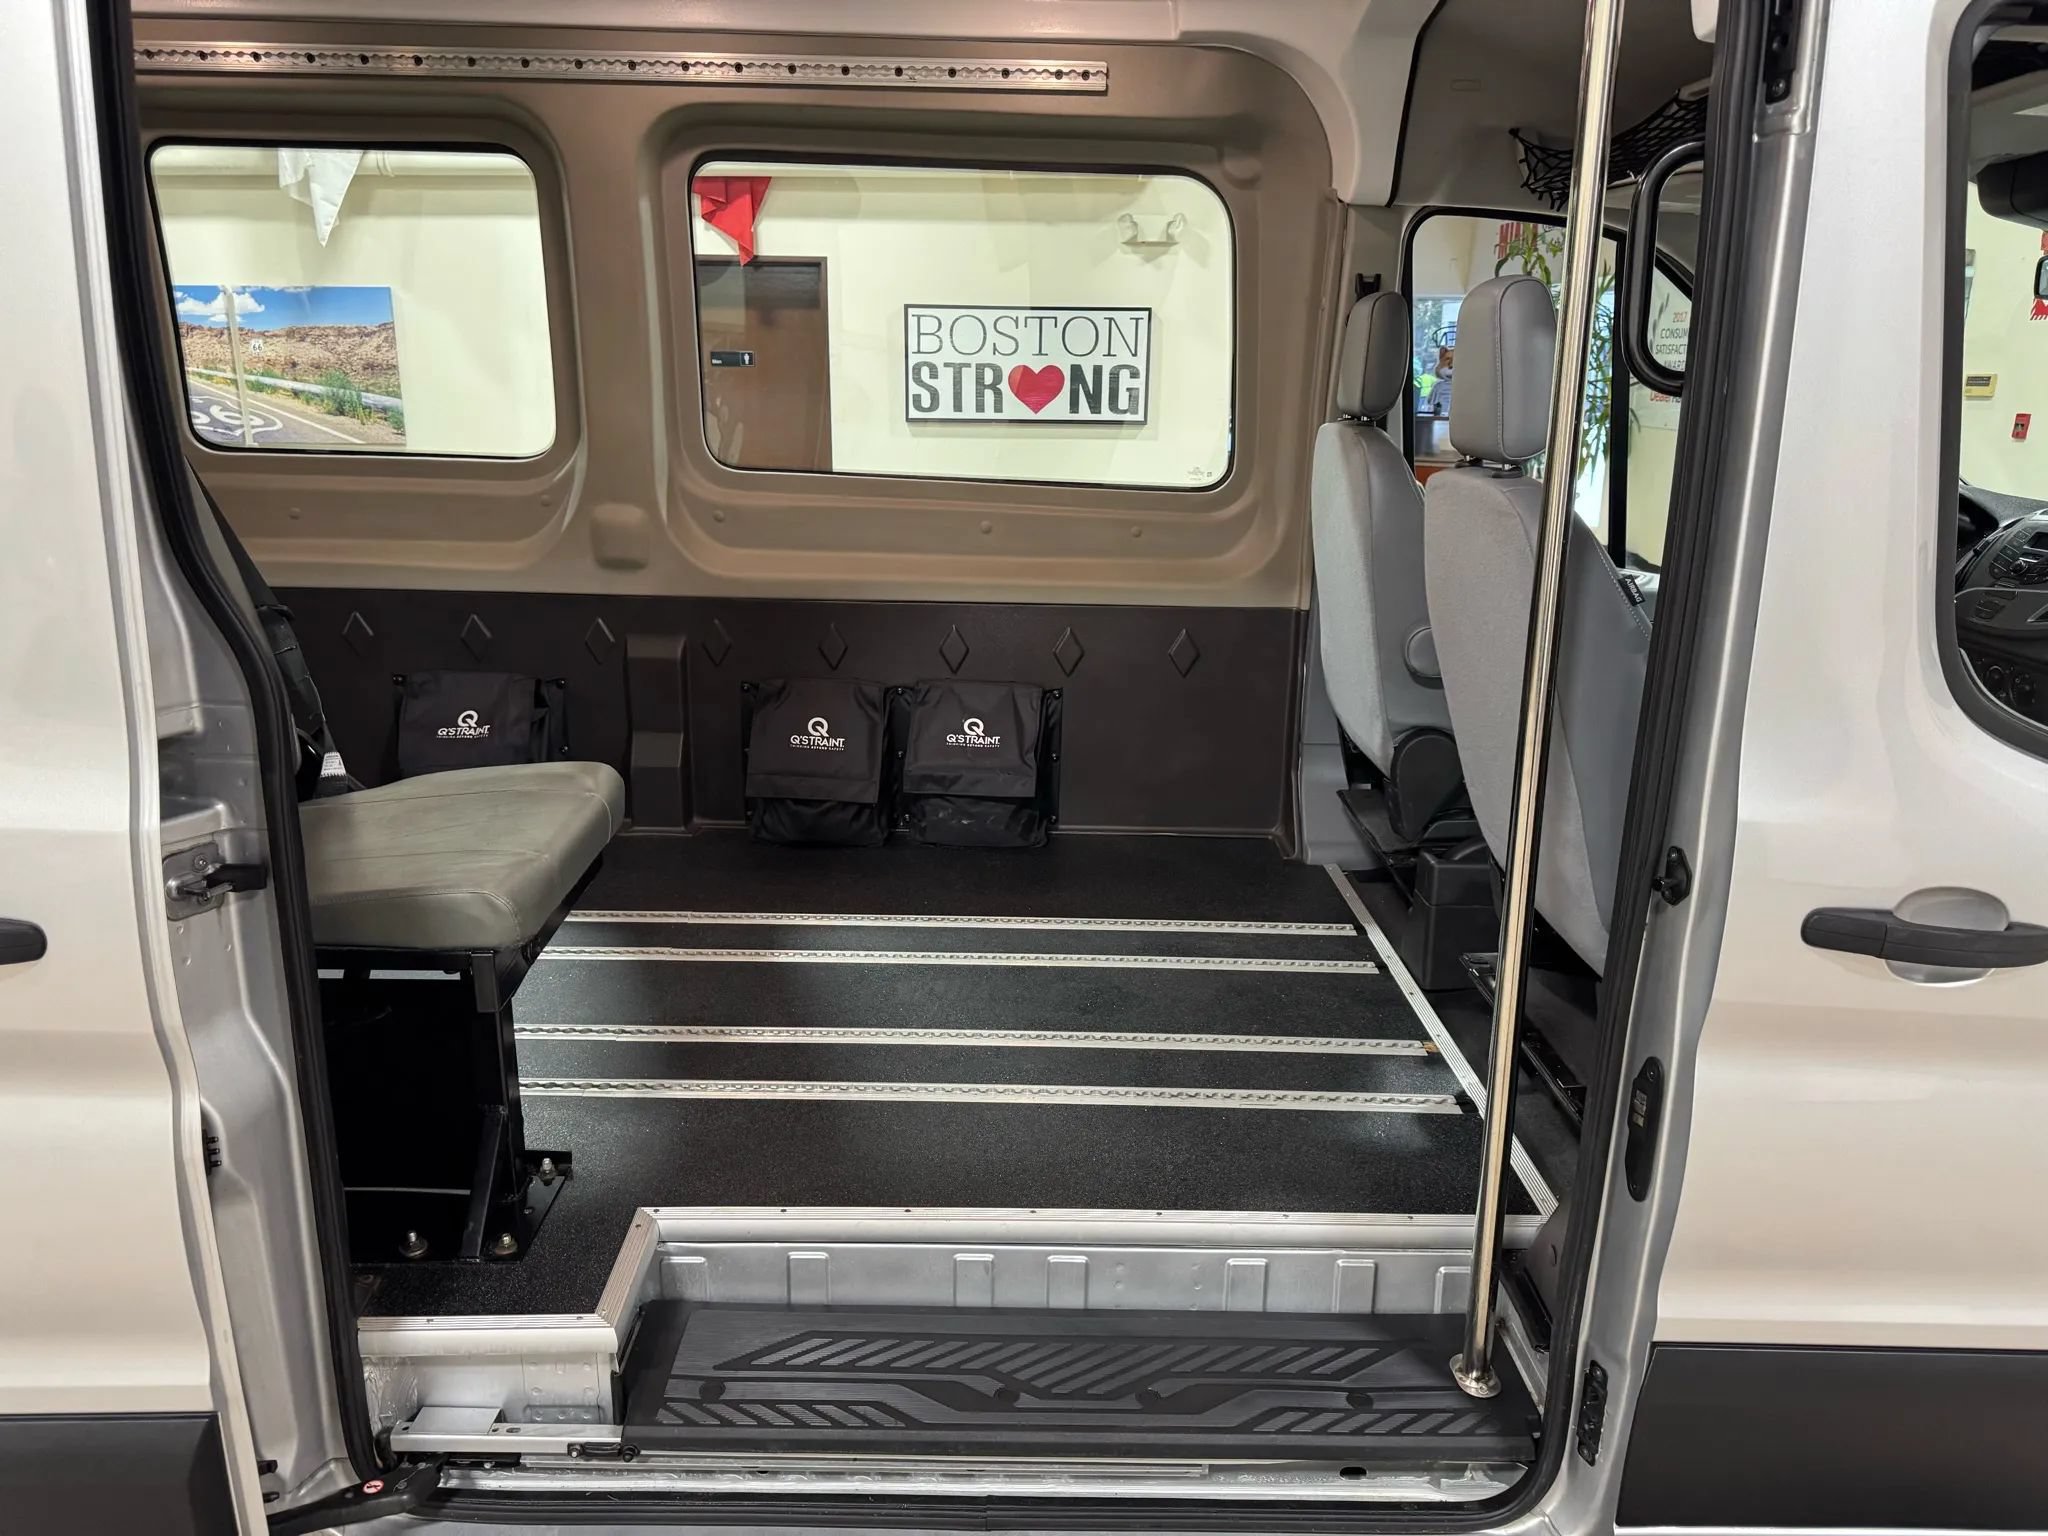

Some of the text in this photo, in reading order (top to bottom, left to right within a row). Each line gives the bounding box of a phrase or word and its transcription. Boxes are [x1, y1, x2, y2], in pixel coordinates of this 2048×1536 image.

[1672, 312, 1688, 323] 2017
[911, 314, 1144, 358] BOSTON
[252, 343, 263, 352] 66
[911, 361, 1141, 415] STRNG
[1625, 578, 1643, 602] AIRBAG
[457, 710, 479, 728] Q
[807, 717, 829, 737] Q
[963, 717, 985, 737] Q
